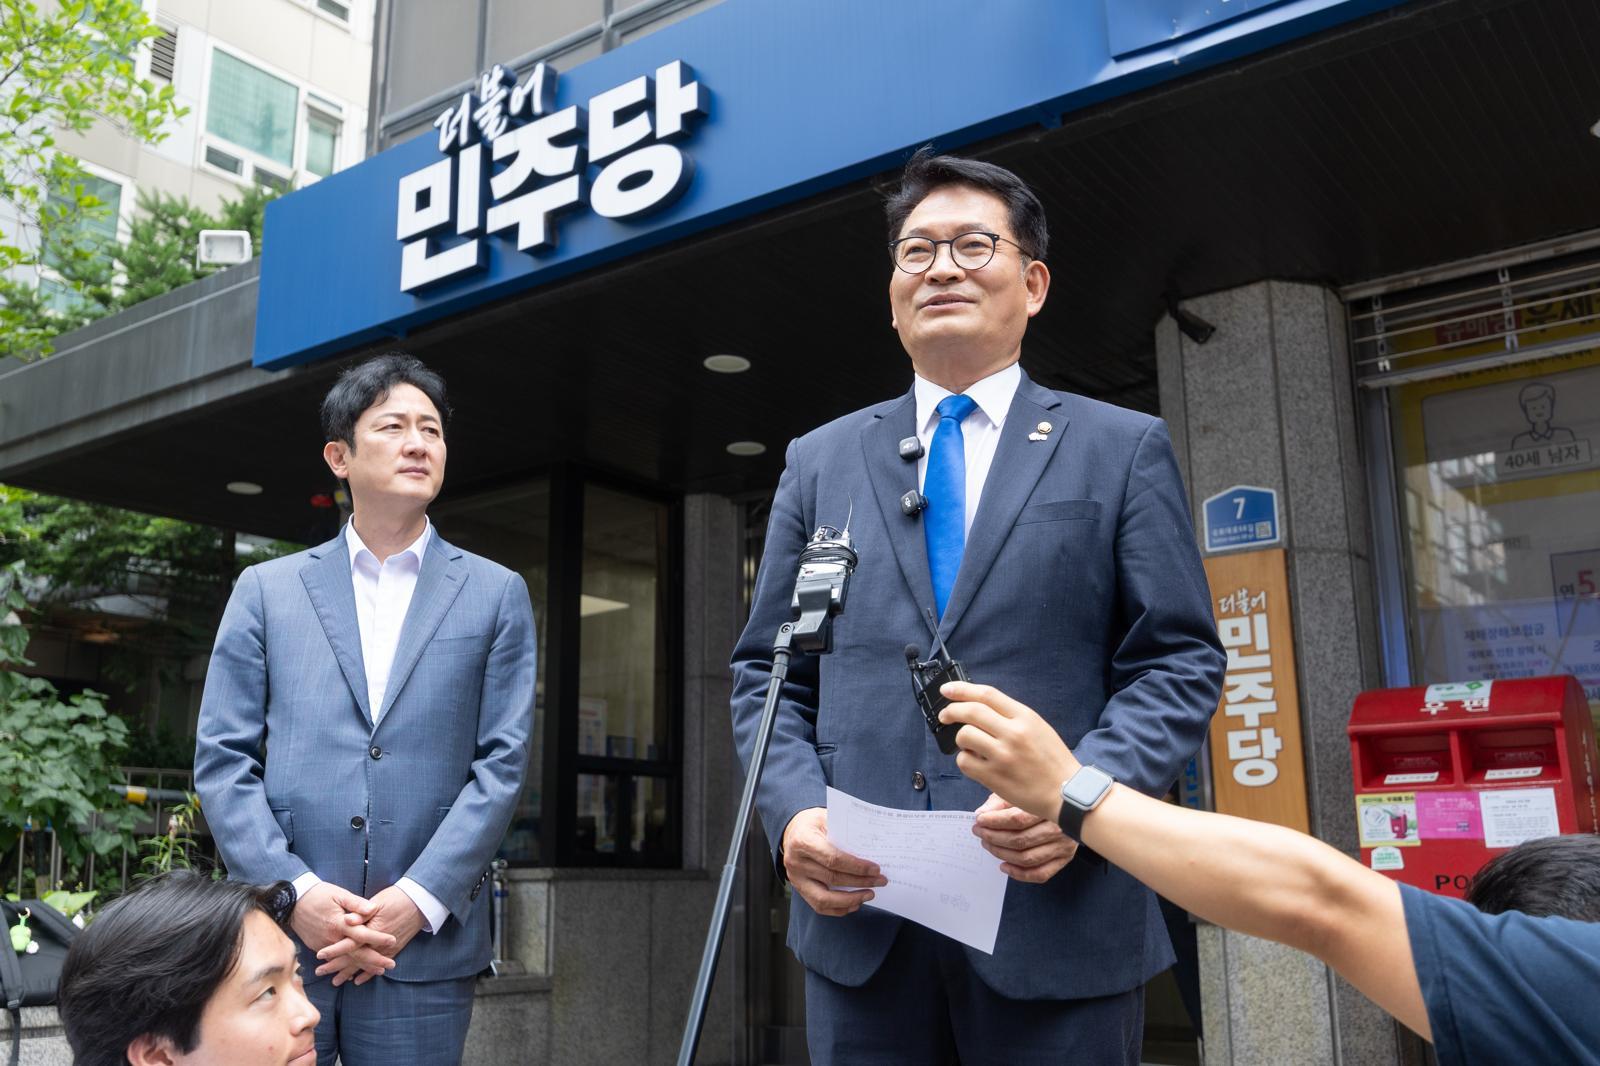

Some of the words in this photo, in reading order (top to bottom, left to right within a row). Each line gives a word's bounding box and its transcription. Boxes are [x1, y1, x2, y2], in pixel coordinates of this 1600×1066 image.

[433, 62, 547, 152] 더불어
[396, 59, 699, 293] 민주당
[1505, 449, 1540, 469] 40세
[1547, 444, 1580, 464] 남자
[1232, 496, 1246, 520] 7
[1218, 587, 1267, 616] 더불어
[1218, 612, 1282, 787] 민주당
